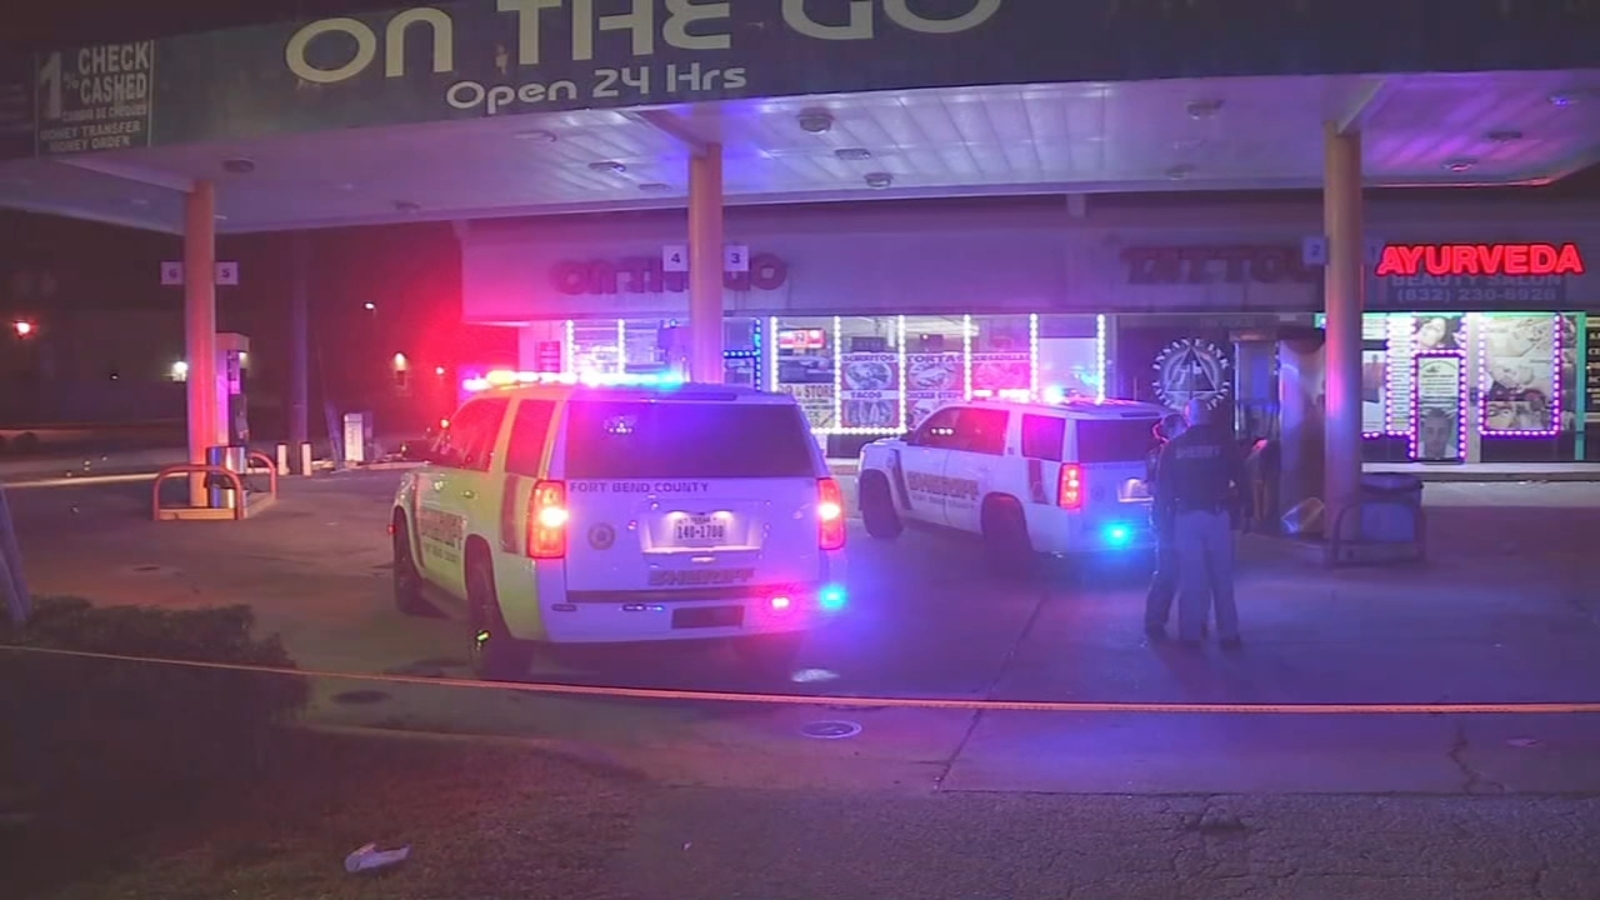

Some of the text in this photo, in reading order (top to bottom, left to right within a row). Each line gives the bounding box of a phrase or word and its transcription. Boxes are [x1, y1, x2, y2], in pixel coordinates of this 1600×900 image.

[285, 7, 453, 83] ON
[497, 0, 731, 65] THE
[79, 41, 149, 75] CHECK
[81, 73, 147, 104] CASHED
[446, 62, 746, 114] Open 24 Hrs
[81, 121, 140, 138] TRANSFER
[92, 135, 131, 150] ORDER
[670, 252, 682, 265] 4
[730, 252, 742, 265] 3
[1376, 244, 1584, 275] AYURVEDA
[168, 268, 178, 279] 6
[221, 267, 231, 279] 5
[850, 391, 882, 399] TACOS
[569, 481, 710, 493] FORT BEND COUNTY
